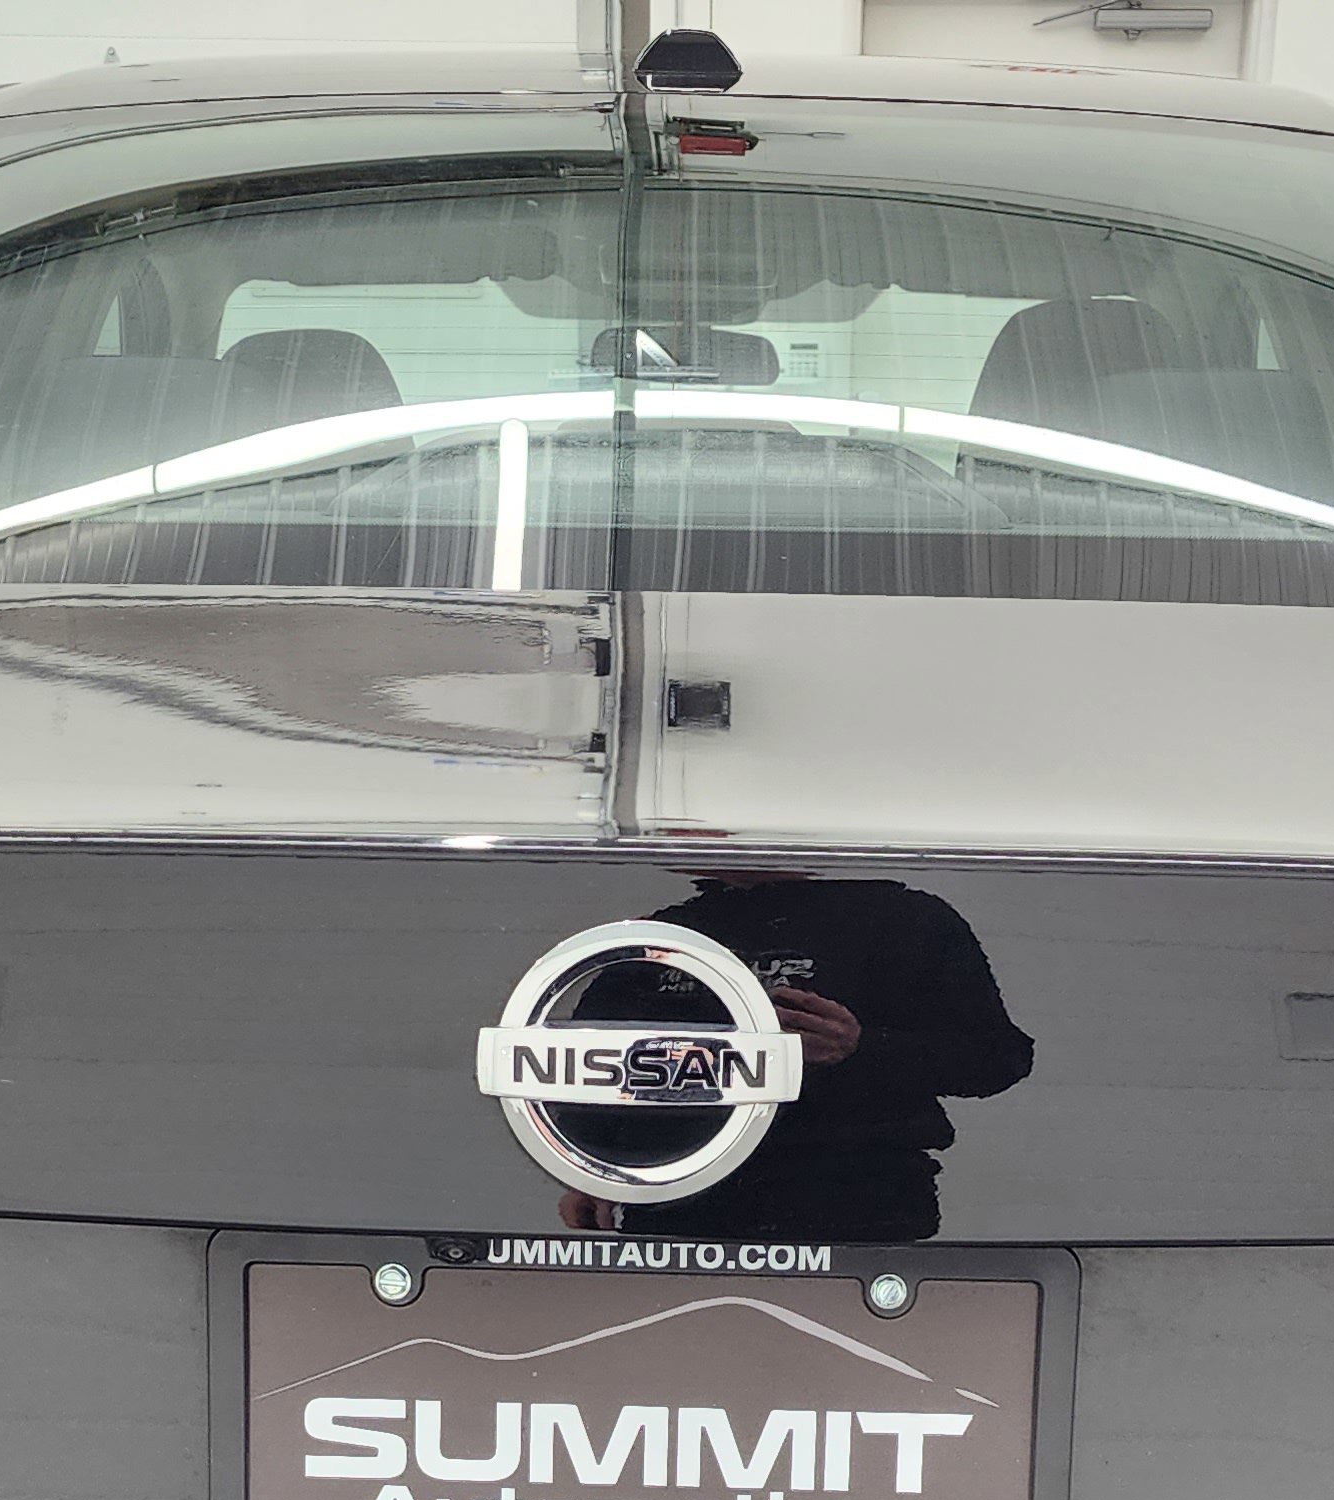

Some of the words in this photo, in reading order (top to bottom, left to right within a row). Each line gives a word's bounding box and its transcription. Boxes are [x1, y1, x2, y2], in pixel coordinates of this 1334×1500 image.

[513, 1045, 767, 1088] NISSAN
[487, 1238, 831, 1271] UMMITAUTO.COM
[303, 1397, 974, 1494] SUMMIT
